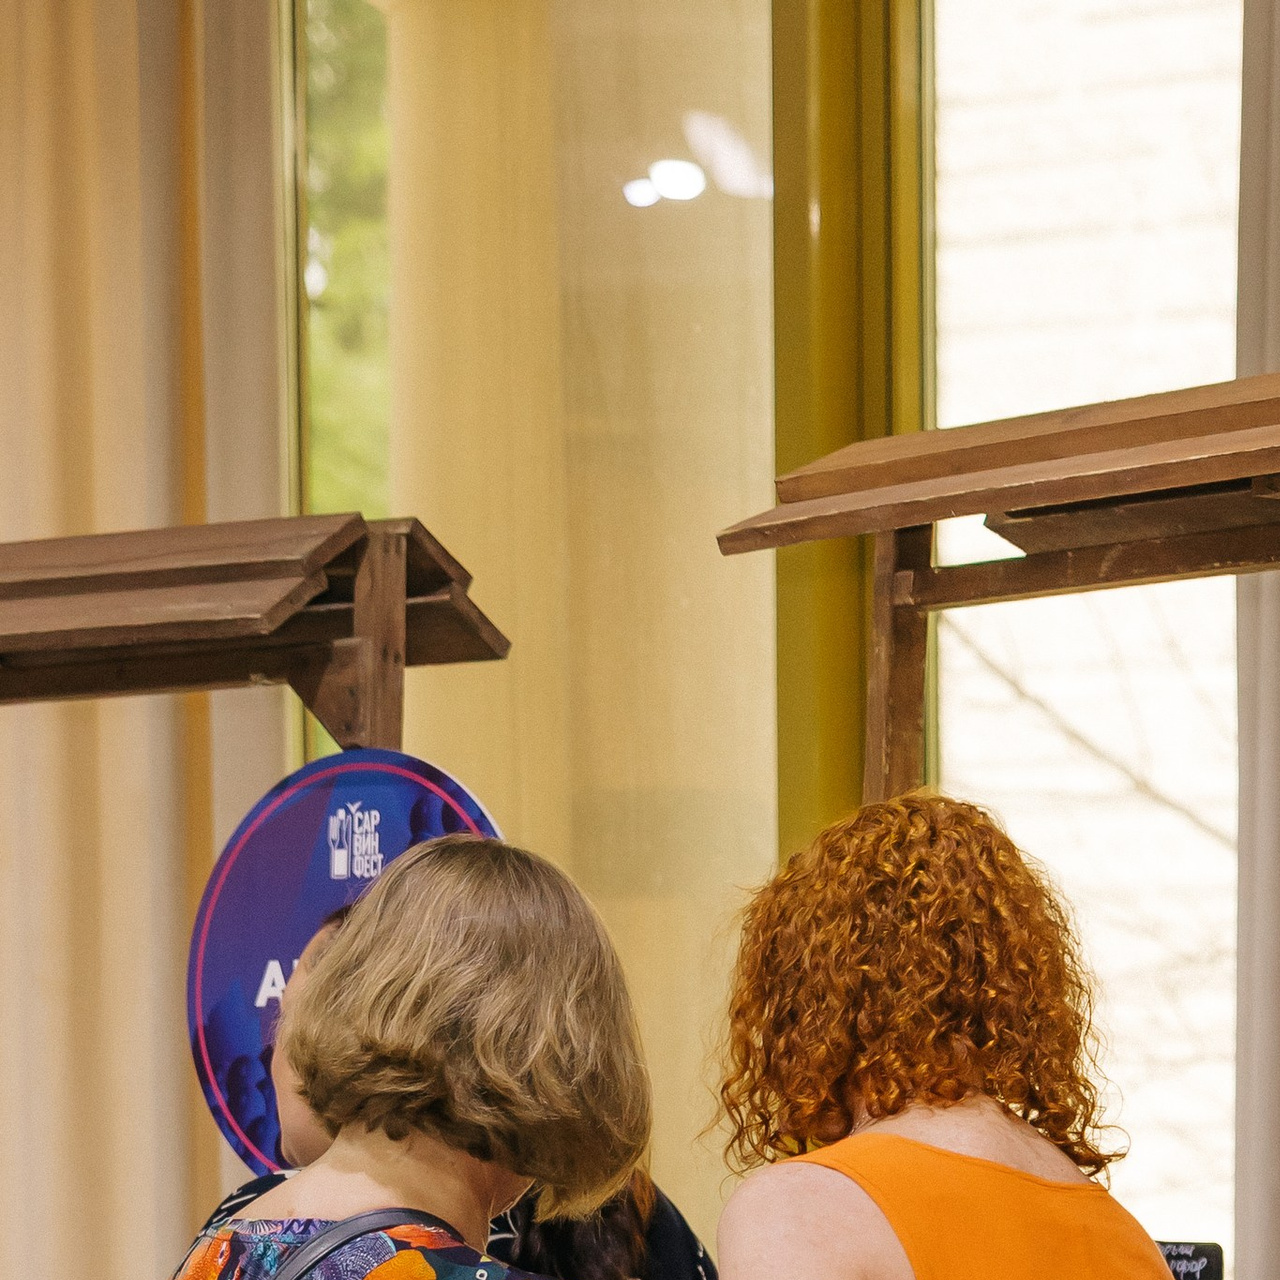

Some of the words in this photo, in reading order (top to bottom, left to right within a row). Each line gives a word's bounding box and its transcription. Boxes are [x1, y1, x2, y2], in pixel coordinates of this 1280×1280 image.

[354, 810, 380, 834] САР
[353, 832, 379, 855] ВИН
[352, 853, 384, 878] ФЕСТ
